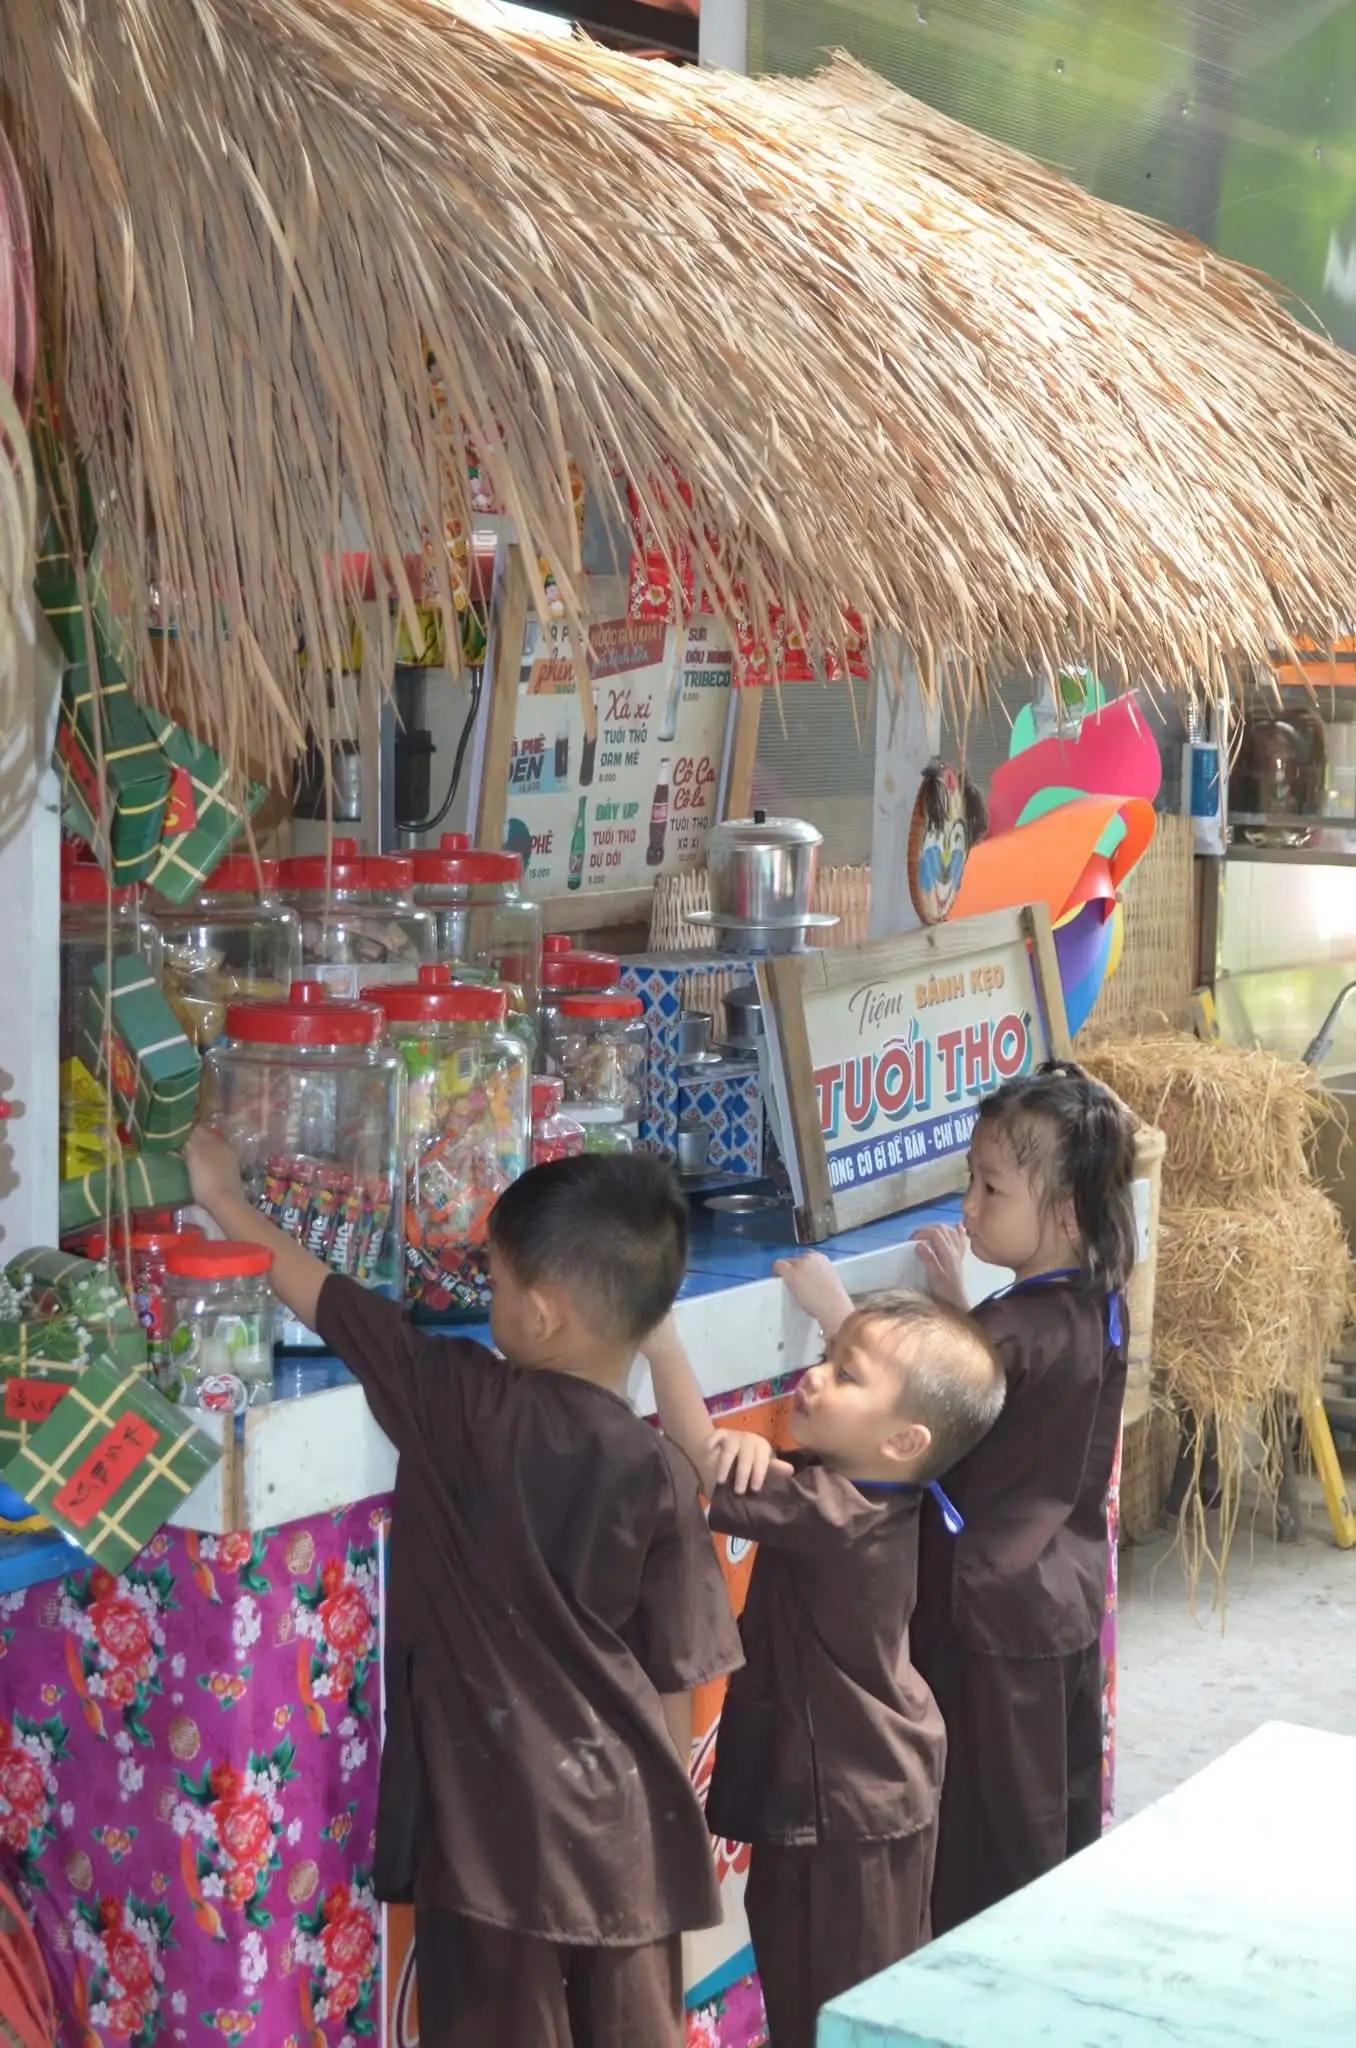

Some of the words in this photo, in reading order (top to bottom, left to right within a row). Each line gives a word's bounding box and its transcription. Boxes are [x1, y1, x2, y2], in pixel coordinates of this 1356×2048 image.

[684, 670, 731, 687] TRIBECO
[849, 981, 903, 1035] Tiệm
[916, 974, 965, 1009] BÁNH
[970, 964, 1004, 997] KẸO
[813, 1017, 932, 1139] TUỔI
[938, 1009, 1032, 1102] THƠ
